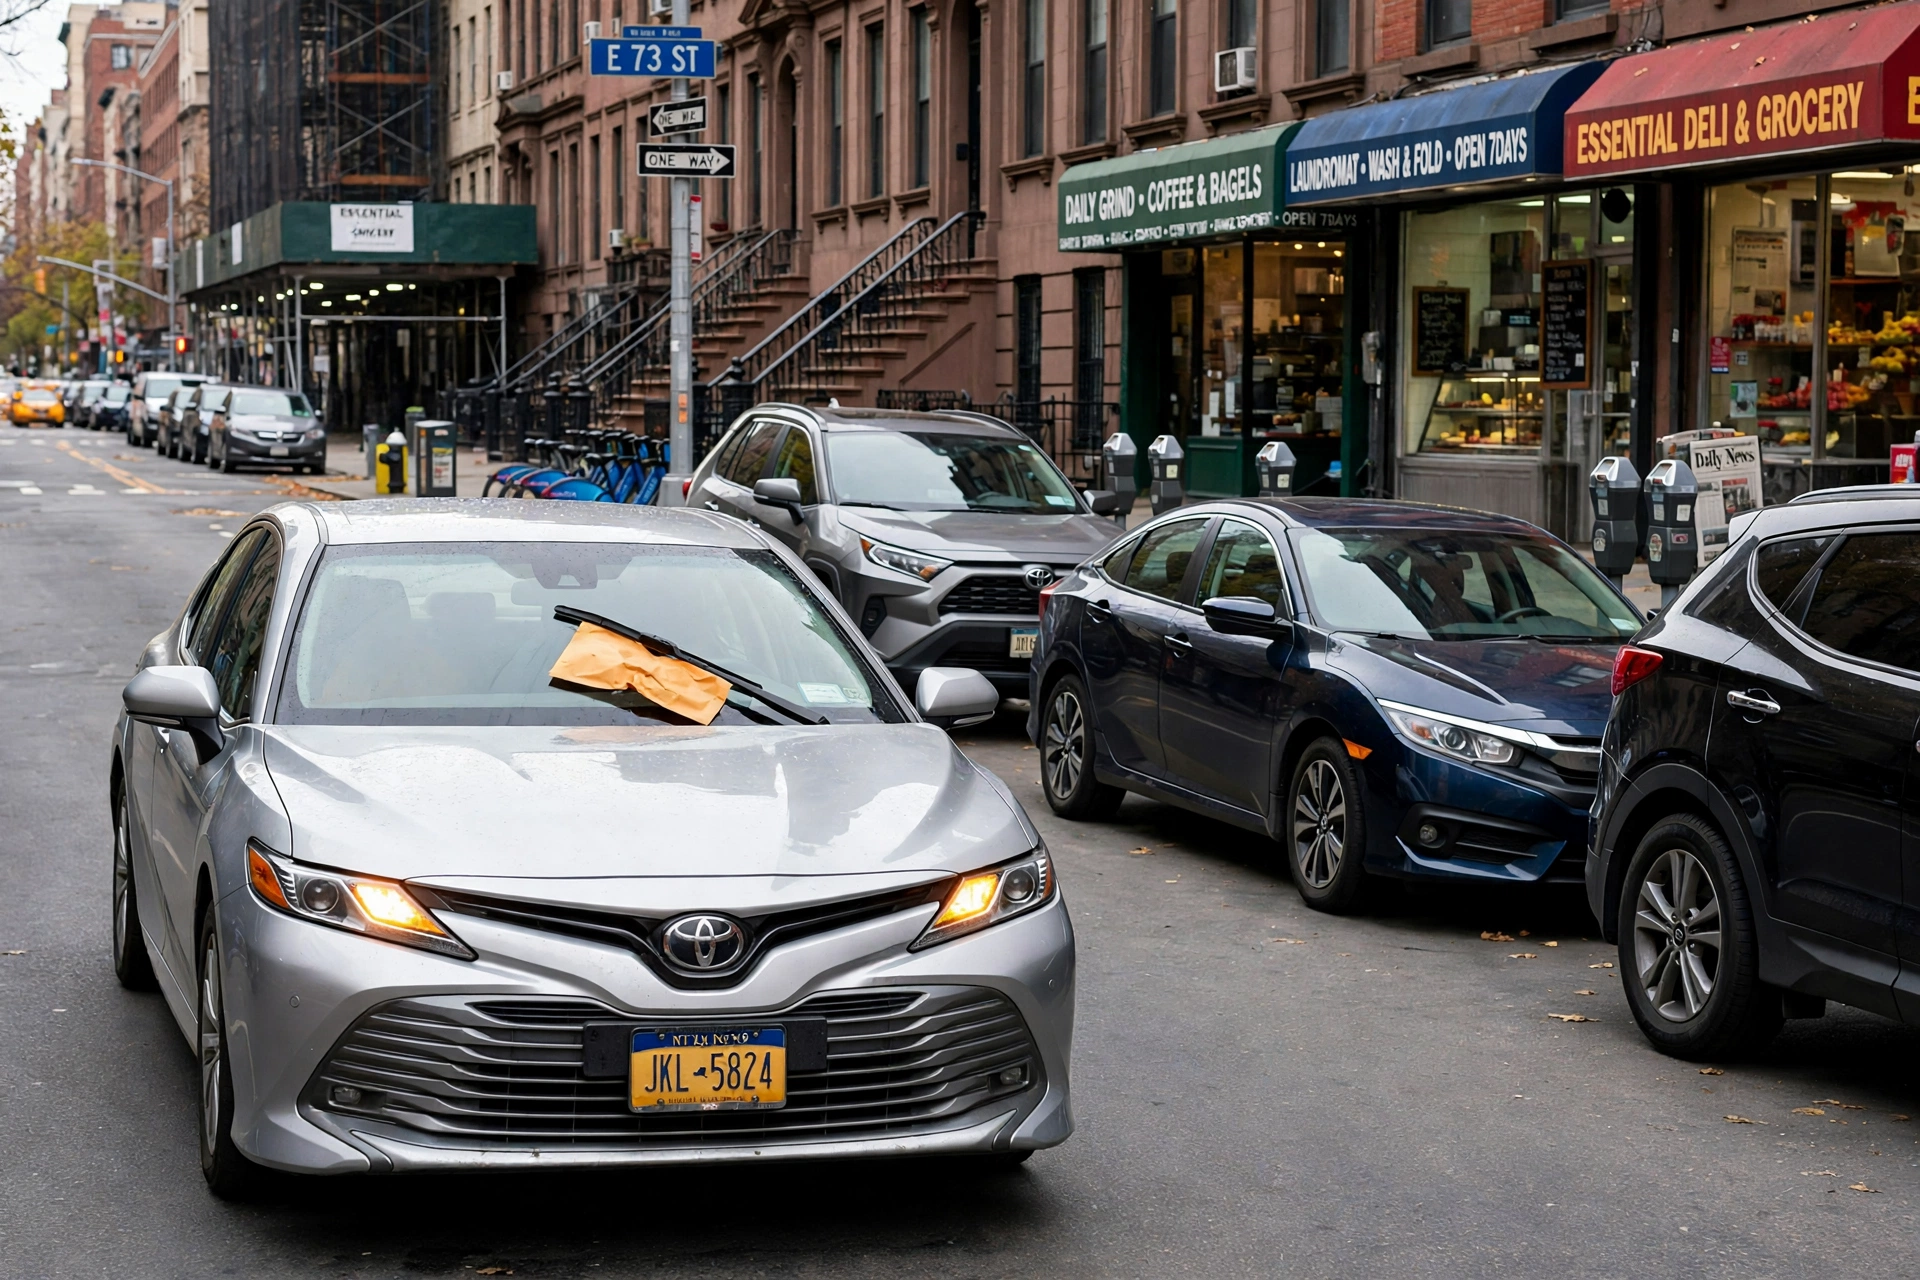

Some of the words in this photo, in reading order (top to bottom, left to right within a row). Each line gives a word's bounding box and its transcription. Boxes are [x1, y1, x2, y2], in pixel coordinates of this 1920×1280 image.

[607, 44, 622, 71] E
[631, 44, 662, 72] 73
[671, 44, 699, 73] ST
[1577, 111, 1678, 164] ESSENTIAL
[1684, 103, 1728, 151] DELI
[1734, 99, 1750, 145] &
[1756, 81, 1864, 142] GROCERY
[649, 153, 676, 167] ONE
[689, 154, 714, 168] WAY
[1290, 152, 1359, 193] LAUNDROMAT
[1368, 147, 1400, 182] WASH
[1402, 145, 1412, 177] &
[1414, 140, 1443, 176] FOLD
[1454, 133, 1486, 171] OPEN
[1488, 126, 1528, 165] 7DAYS
[1065, 190, 1097, 225] DAILY
[1098, 185, 1136, 221] GRIND
[1147, 174, 1195, 214] COFFEE
[1196, 173, 1208, 206] &
[1209, 164, 1262, 205] BAGELS
[1282, 211, 1316, 226] OPEN
[644, 1053, 689, 1093] JKL
[710, 1051, 773, 1092] 5824
